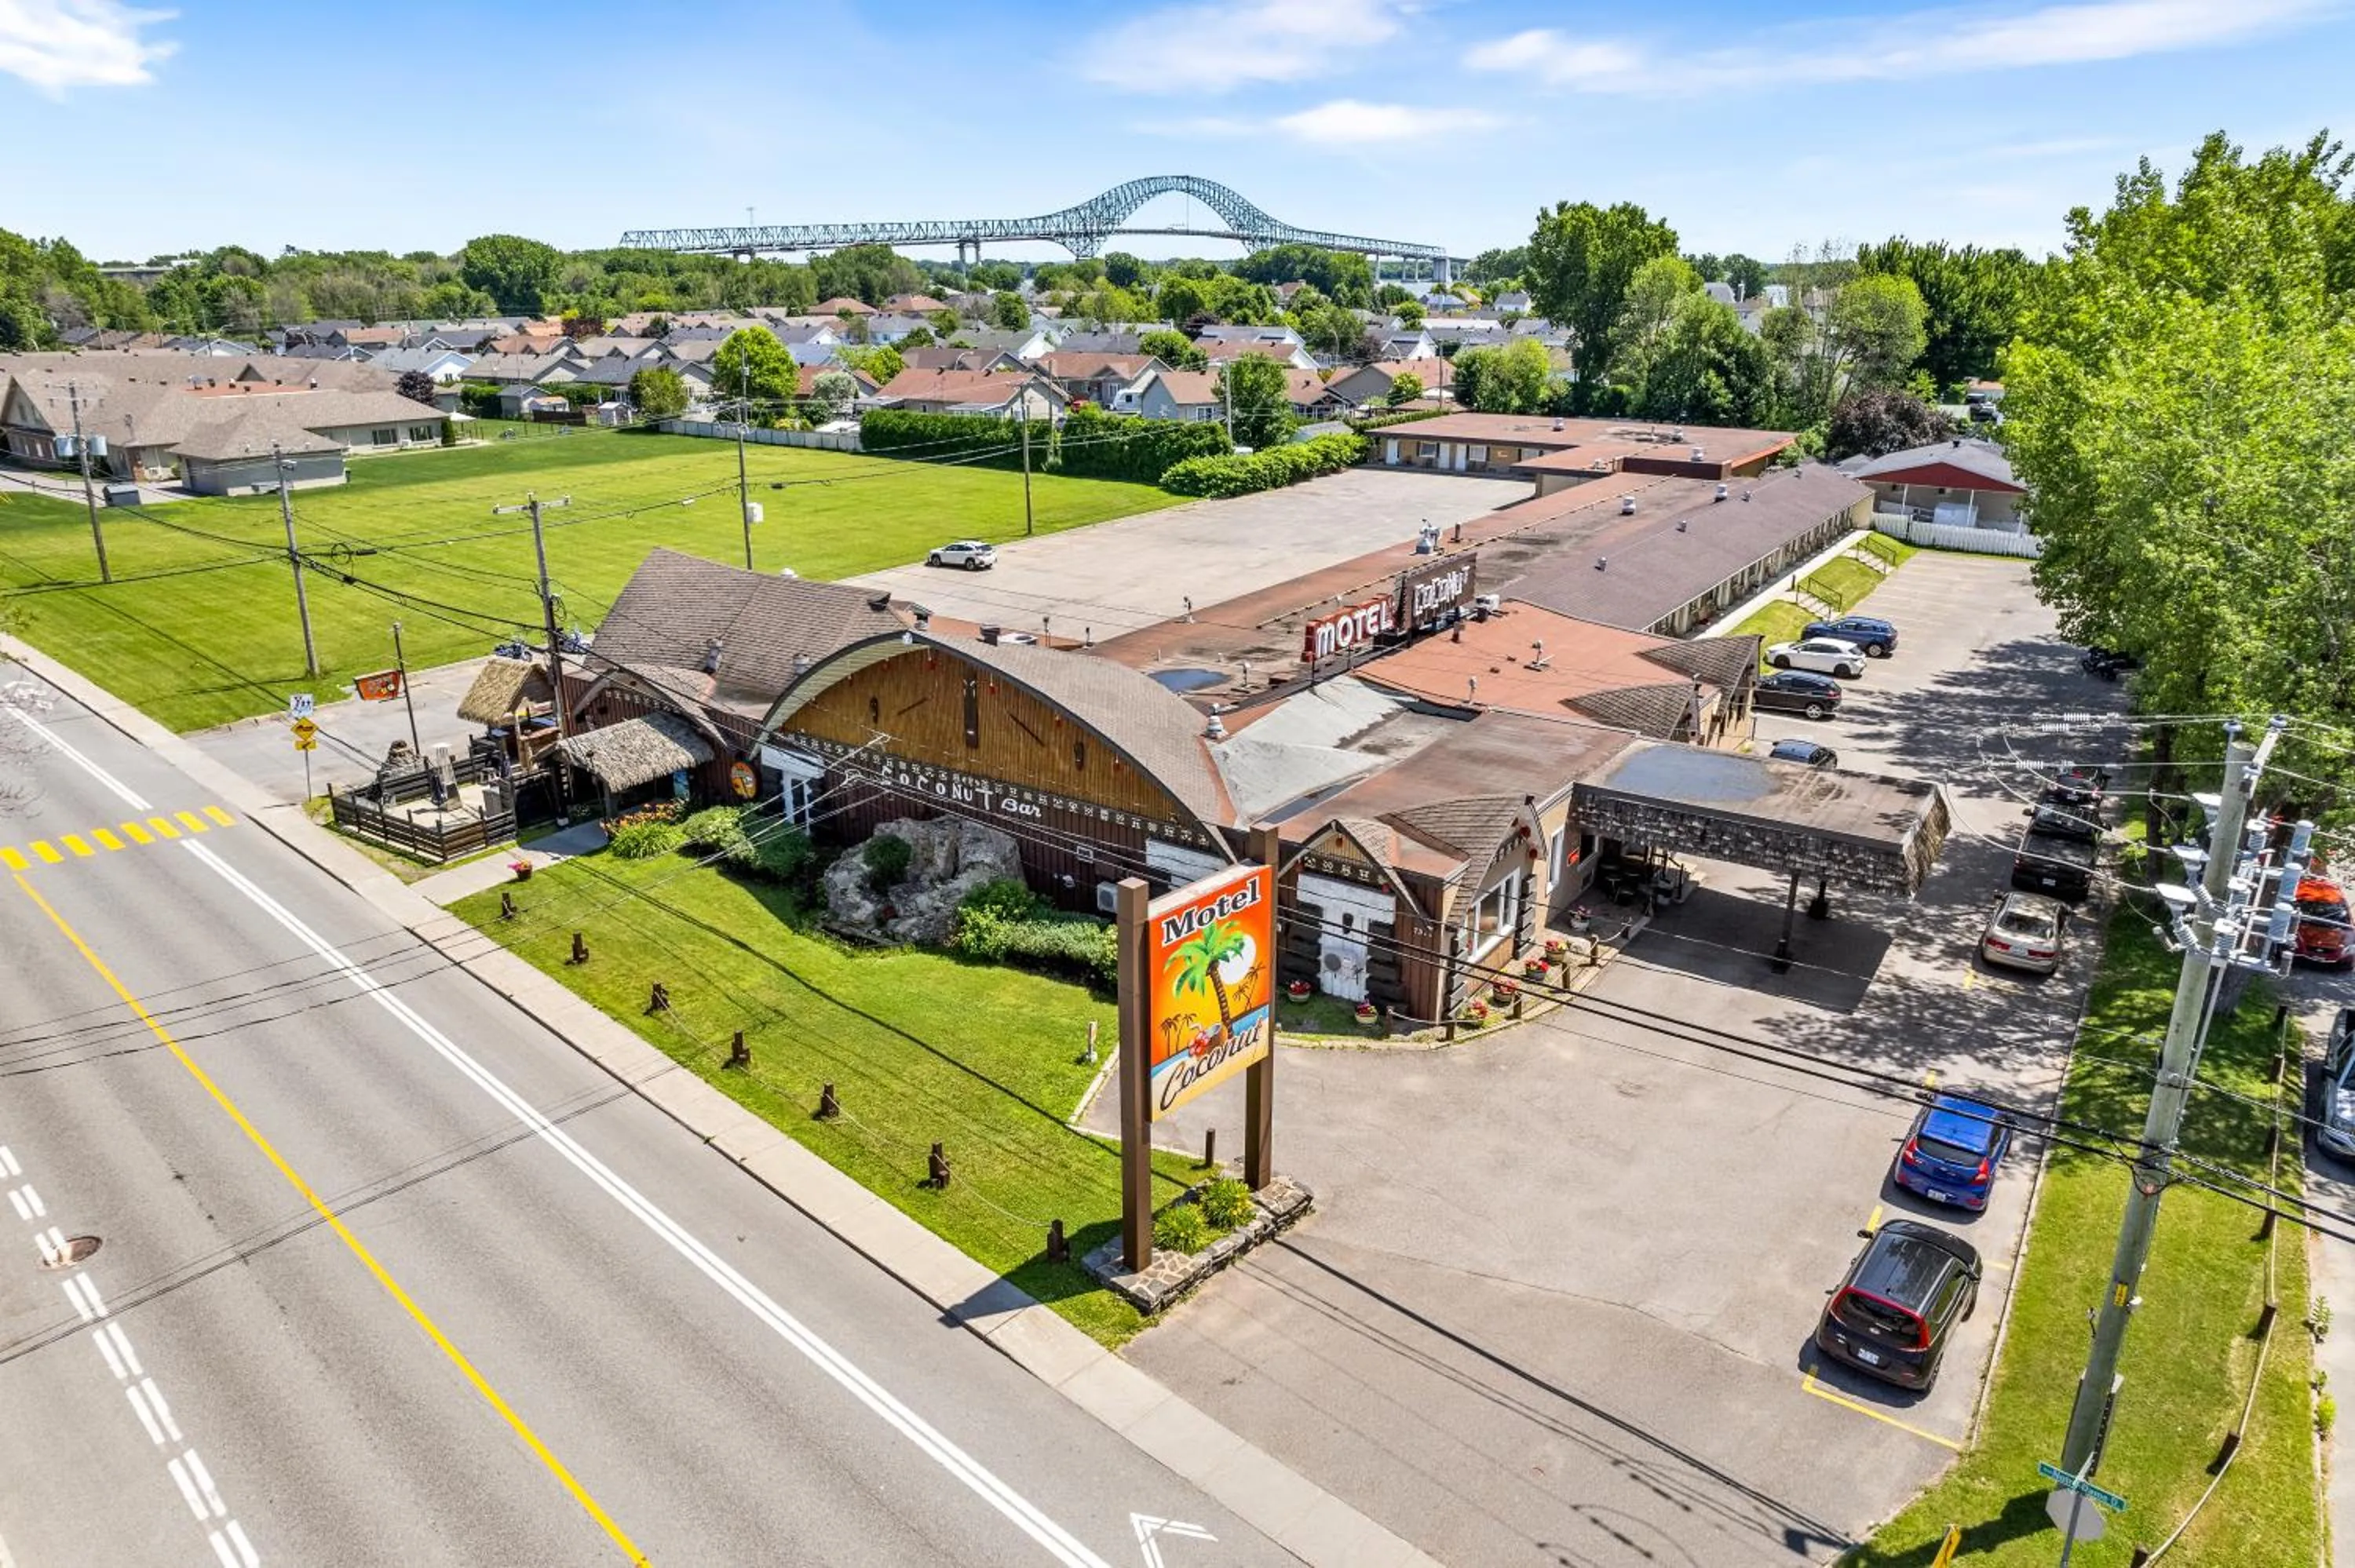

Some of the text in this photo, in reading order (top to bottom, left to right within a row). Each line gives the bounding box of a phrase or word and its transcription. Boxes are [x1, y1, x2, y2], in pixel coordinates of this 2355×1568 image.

[1001, 798, 1043, 818] Bar
[1162, 878, 1261, 946] Motel
[1160, 1018, 1263, 1111] Coconut
